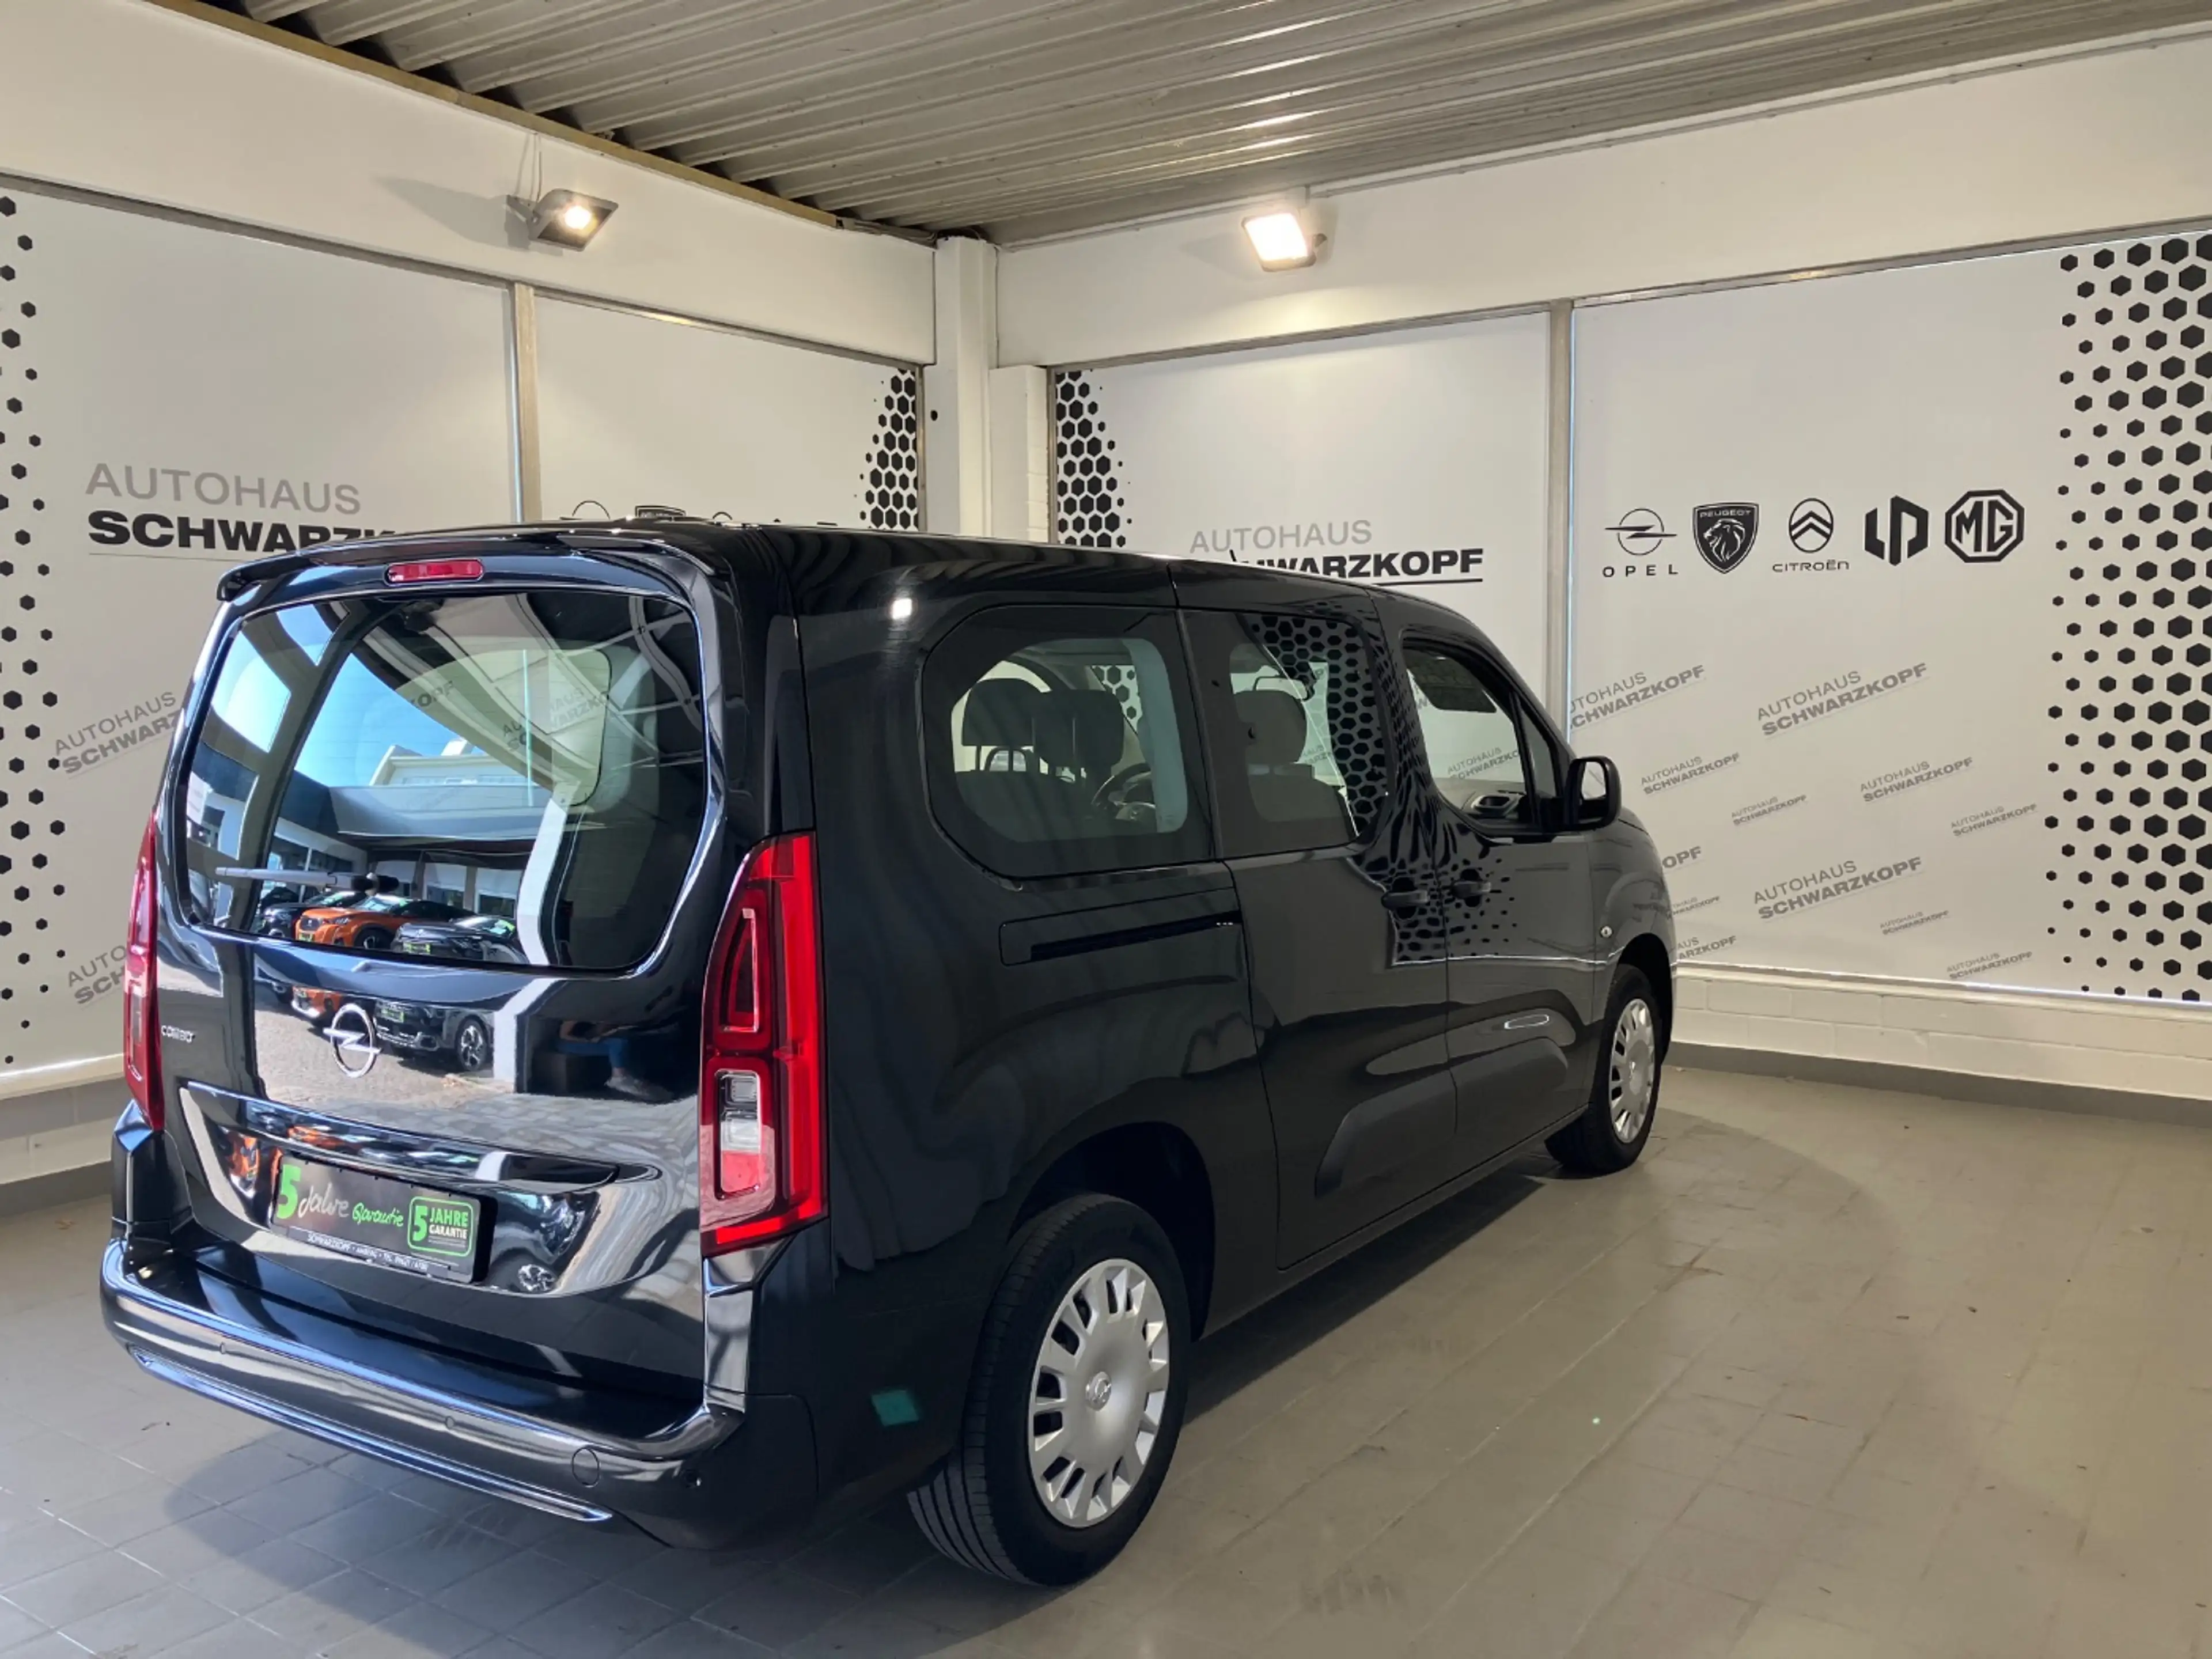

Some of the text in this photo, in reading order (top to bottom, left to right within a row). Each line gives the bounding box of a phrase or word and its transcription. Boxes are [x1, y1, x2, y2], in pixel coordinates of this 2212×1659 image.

[85, 463, 361, 515] AUTOHAUS
[1699, 509, 1751, 518] PEUGEOT
[1952, 497, 2017, 555] MG
[1190, 520, 1372, 554] AUTOHAUS
[1603, 564, 1679, 578] OPEL
[1571, 665, 1705, 729] CHWARZKOPF
[1758, 671, 1861, 721] AUTOHAUS
[1762, 662, 1927, 736] SCHWARZKOPF
[56, 692, 176, 756] AUTOHAUS
[1641, 756, 1702, 785] AUTOHAUS
[1643, 752, 1740, 795] SCHWARZKOPF
[1860, 760, 1930, 792] AUTOHAUS
[1863, 756, 1973, 802] SCHWARZKOPF
[1754, 861, 1857, 904] AUTOHAUS
[1758, 857, 1922, 919] SCHWARZKOPF
[276, 1164, 301, 1219] 5
[412, 1205, 468, 1241] 5 JAHRE
